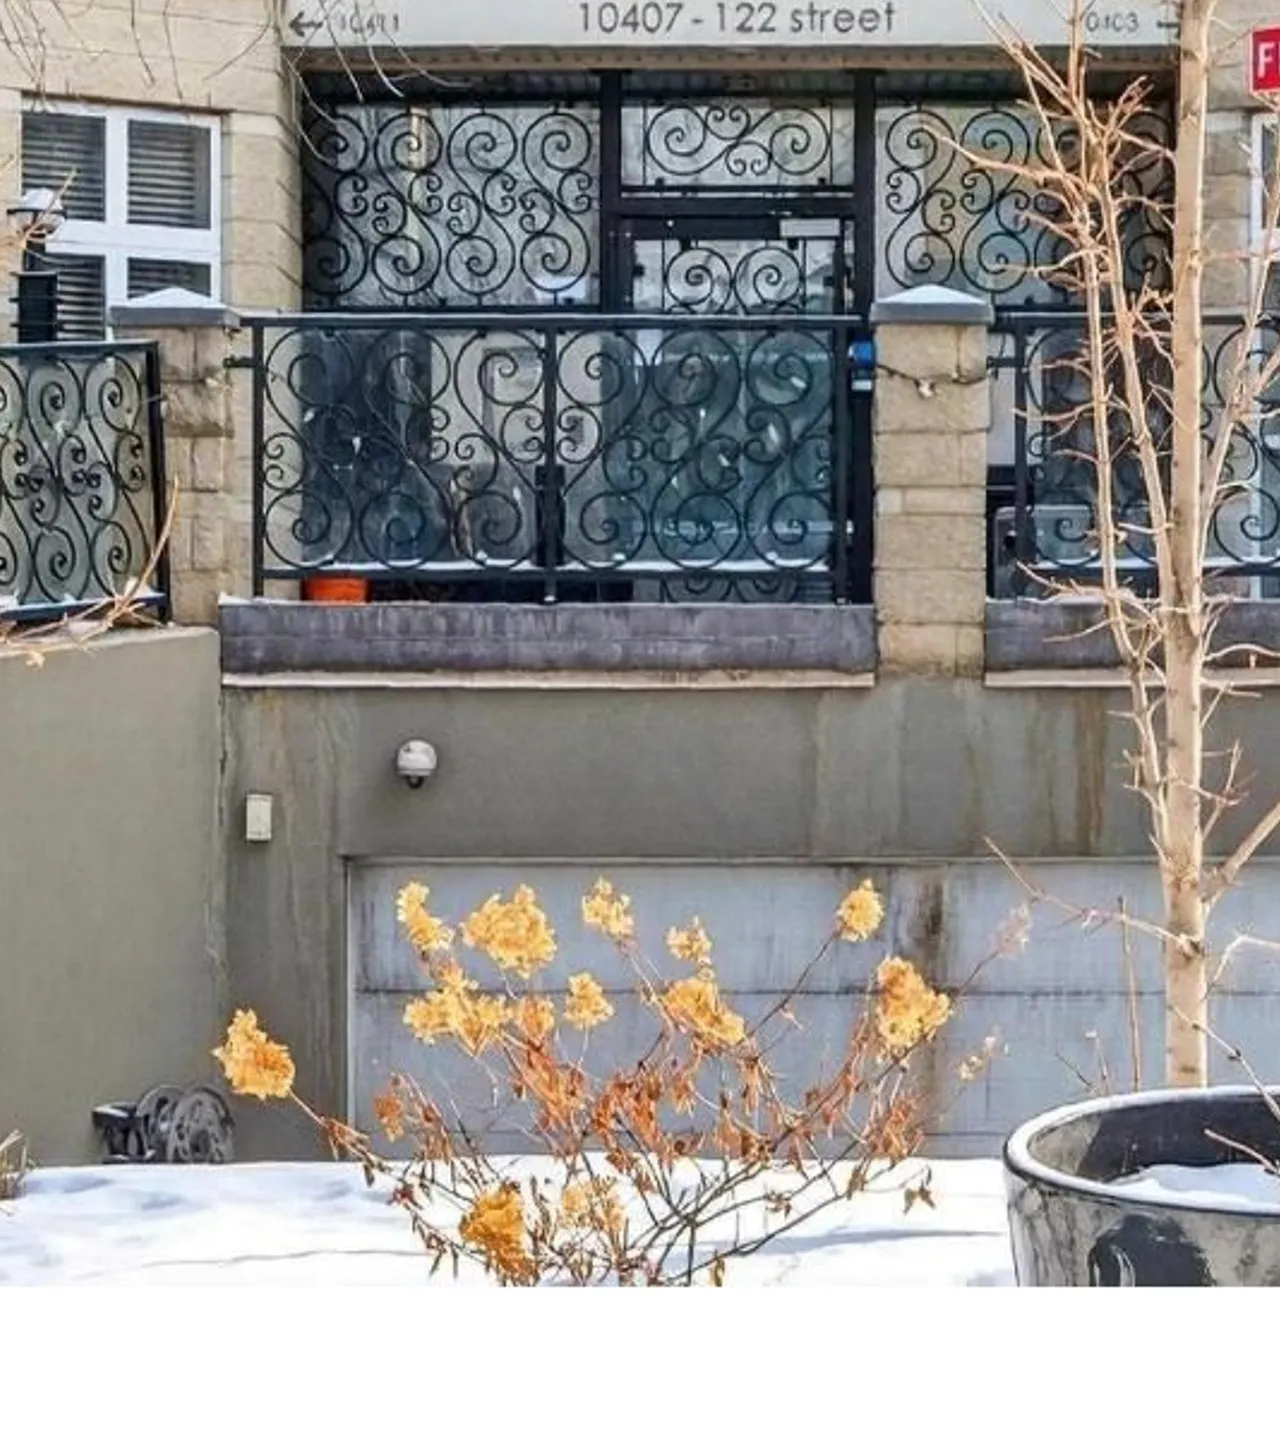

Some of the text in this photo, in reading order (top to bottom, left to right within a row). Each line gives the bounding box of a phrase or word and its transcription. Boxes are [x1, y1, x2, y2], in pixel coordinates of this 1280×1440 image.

[580, 1, 684, 34] 10407
[717, 1, 777, 34] 122
[790, 1, 896, 34] street
